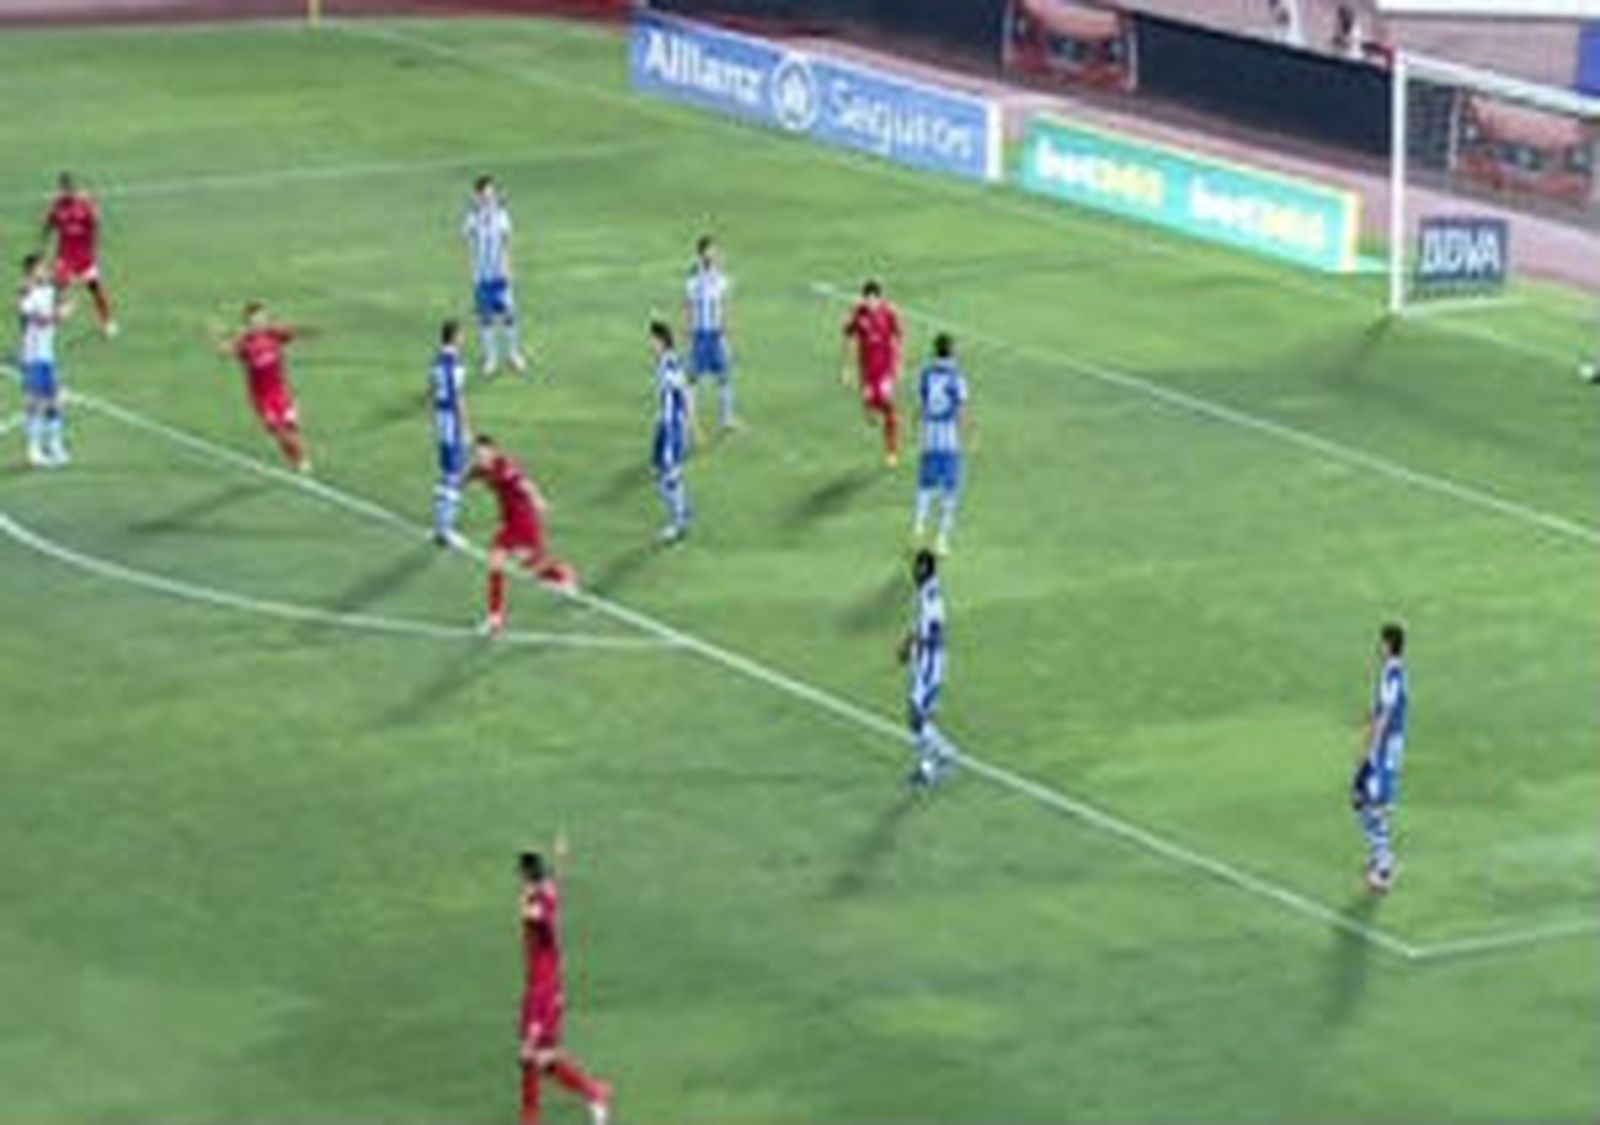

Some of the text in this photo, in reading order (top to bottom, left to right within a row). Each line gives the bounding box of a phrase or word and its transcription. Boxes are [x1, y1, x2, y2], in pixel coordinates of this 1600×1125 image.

[644, 28, 973, 161] Allianz Seguros
[1190, 172, 1328, 249] bet
[1422, 227, 1500, 275] BBVA
